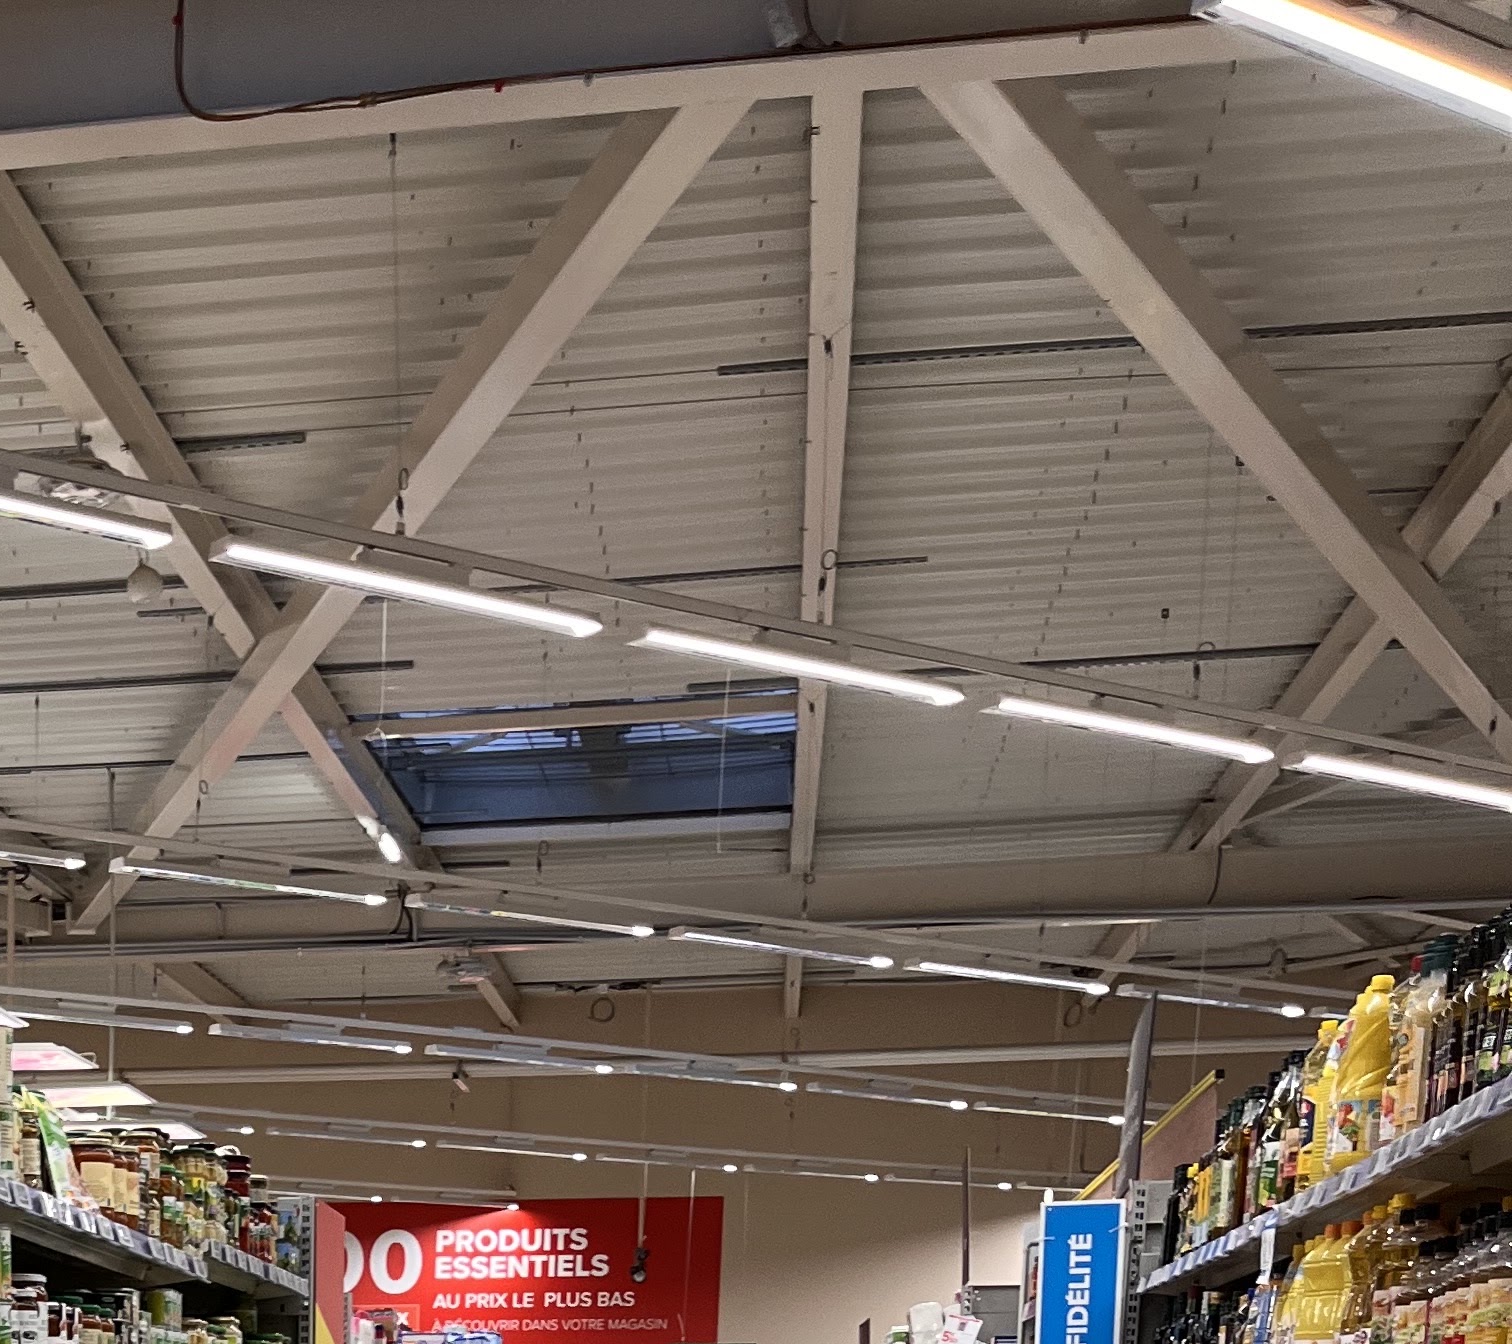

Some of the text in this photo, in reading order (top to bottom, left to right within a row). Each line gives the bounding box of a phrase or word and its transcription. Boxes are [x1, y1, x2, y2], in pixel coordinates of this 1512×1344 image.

[435, 1228, 589, 1253] PRODUITS
[434, 1254, 610, 1280] ESSENTIELS
[432, 1291, 636, 1309] AU PRIX LE PLUS BAS
[522, 1318, 559, 1331] DANS
[561, 1317, 605, 1331] VOTRE
[607, 1317, 668, 1331] MAGASIN
